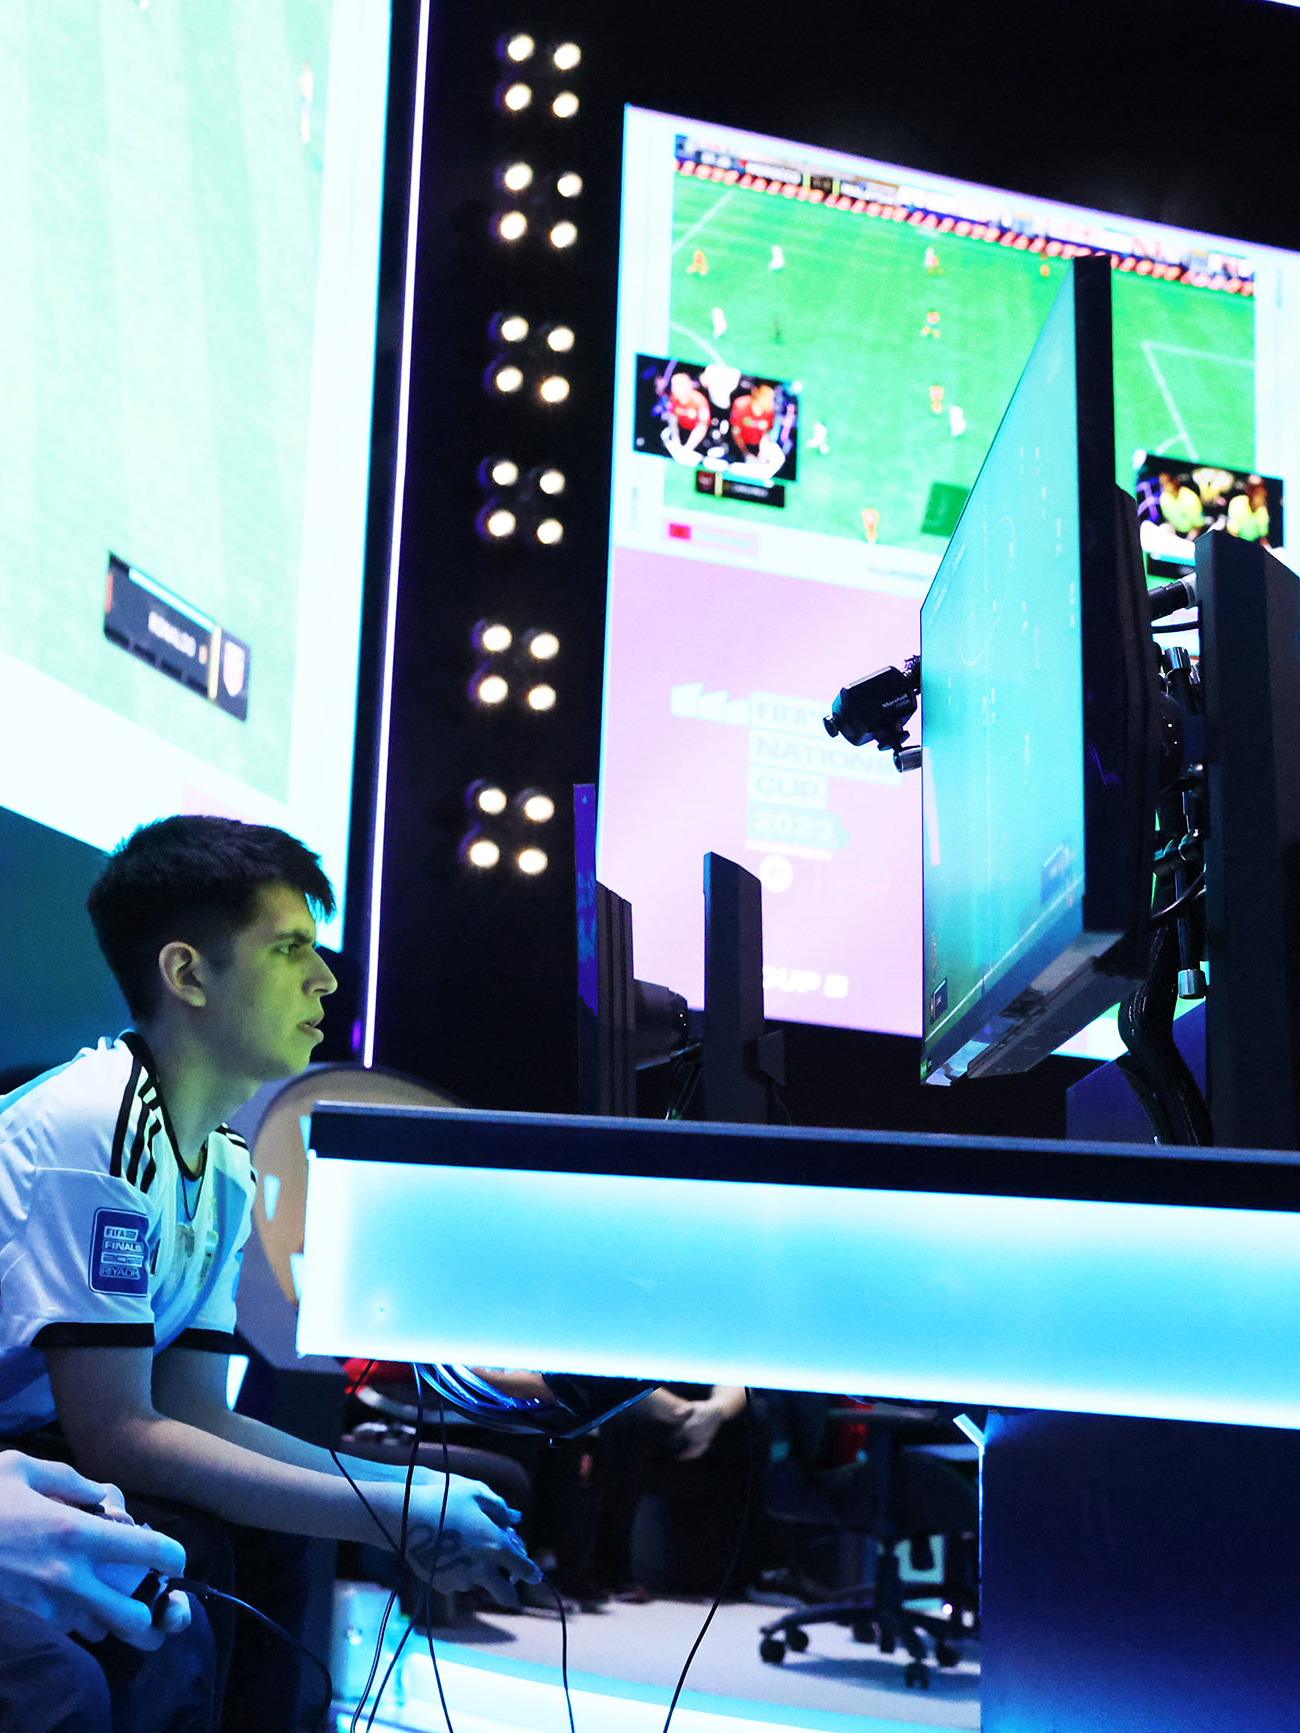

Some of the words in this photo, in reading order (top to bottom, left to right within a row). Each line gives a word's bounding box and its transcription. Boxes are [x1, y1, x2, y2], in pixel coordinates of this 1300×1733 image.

[756, 774, 820, 798] CUP
[752, 808, 836, 842] 2023
[104, 1240, 142, 1252] FINALS
[101, 1265, 140, 1278] RIYADH
